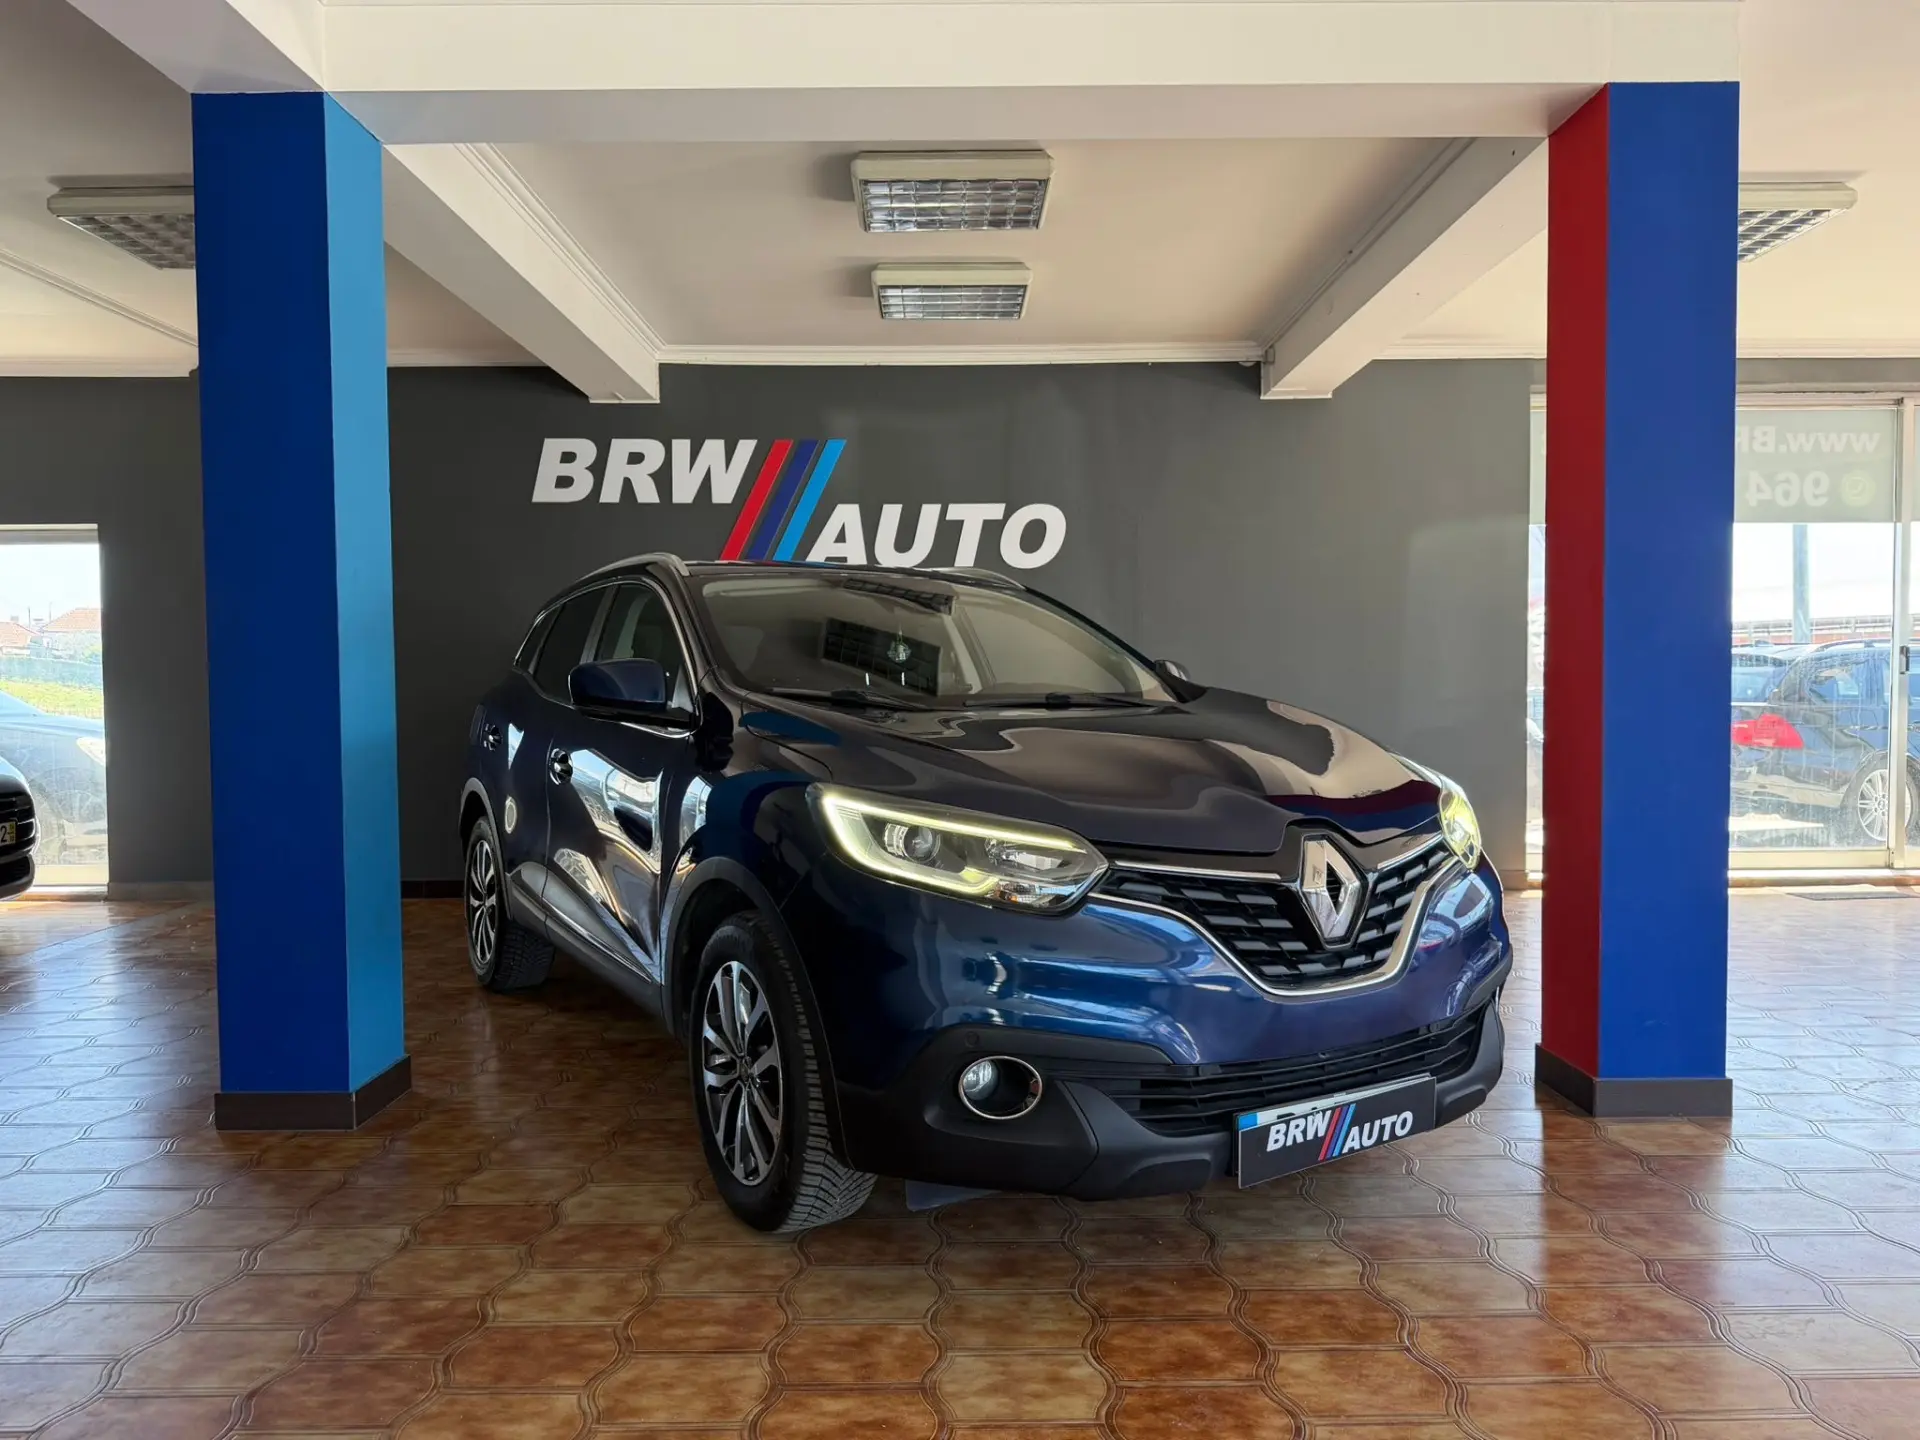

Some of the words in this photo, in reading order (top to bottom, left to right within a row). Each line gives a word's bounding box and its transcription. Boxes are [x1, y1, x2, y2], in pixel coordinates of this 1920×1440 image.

[531, 438, 757, 503] BRW
[805, 503, 1067, 569] AUTO
[1266, 1109, 1332, 1152] BRW
[1342, 1110, 1414, 1154] AUTO
